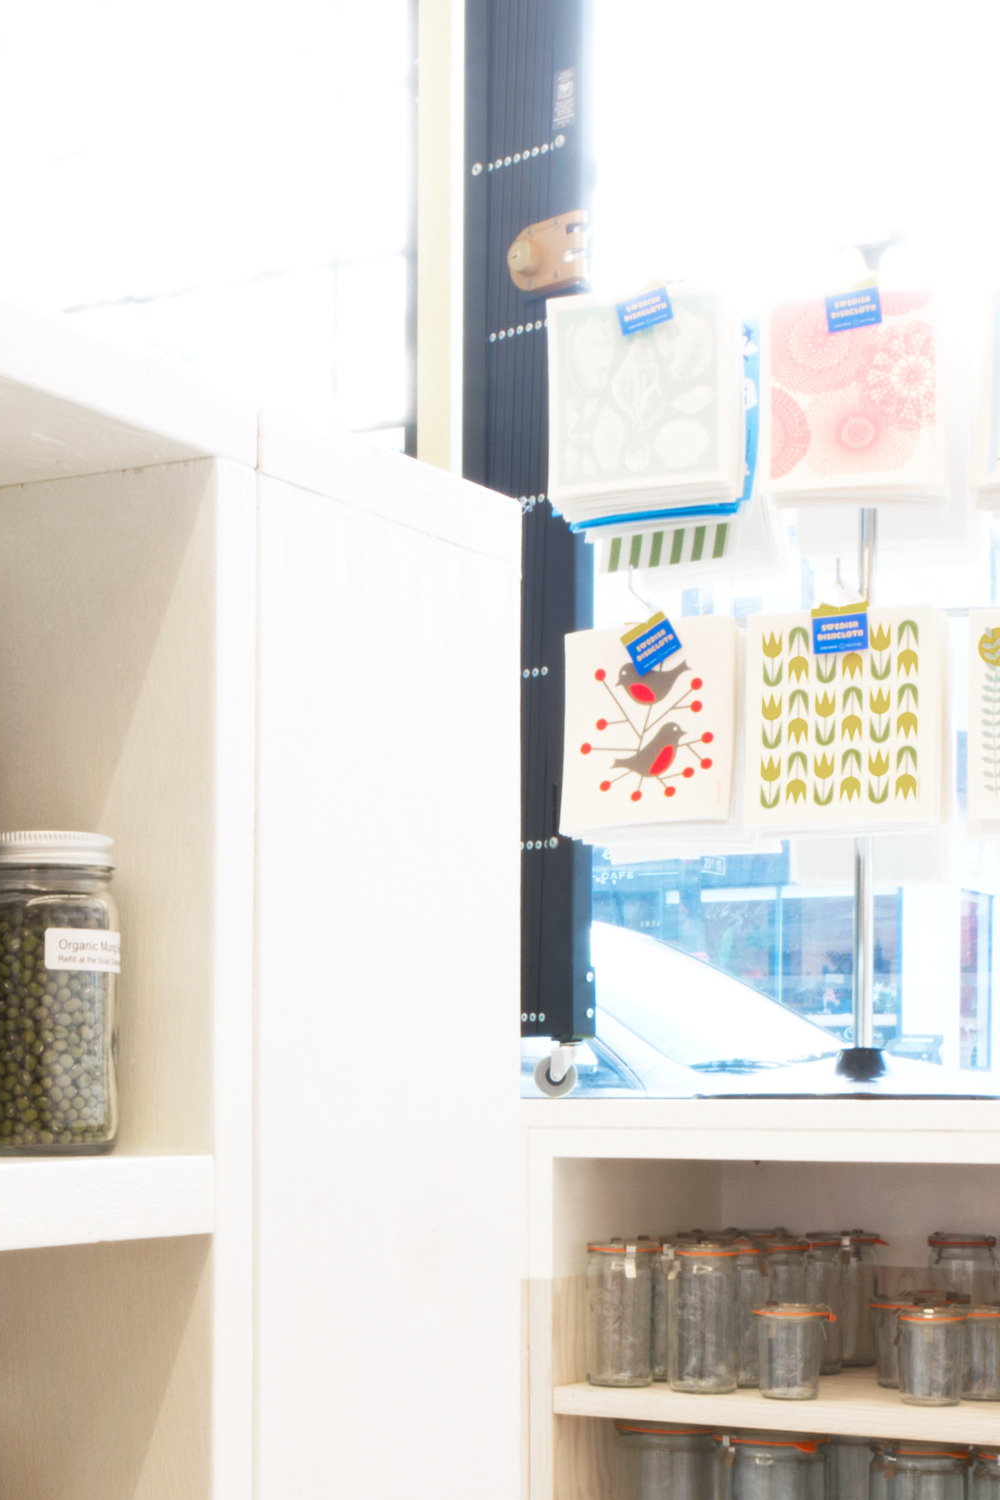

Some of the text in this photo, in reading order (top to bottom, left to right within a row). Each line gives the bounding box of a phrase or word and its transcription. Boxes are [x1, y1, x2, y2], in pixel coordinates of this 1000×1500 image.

[626, 296, 661, 313] SWEDISH
[834, 295, 871, 309] SWEDISH
[624, 302, 668, 322] DISHCLOTH
[831, 303, 877, 319] DISHCLOTH
[821, 620, 859, 632] SWEDISH
[635, 627, 667, 653] SWEDISH
[816, 628, 864, 642] DISHCLOTH
[636, 632, 674, 663] DISHCLOTH
[58, 938, 98, 953] Organic
